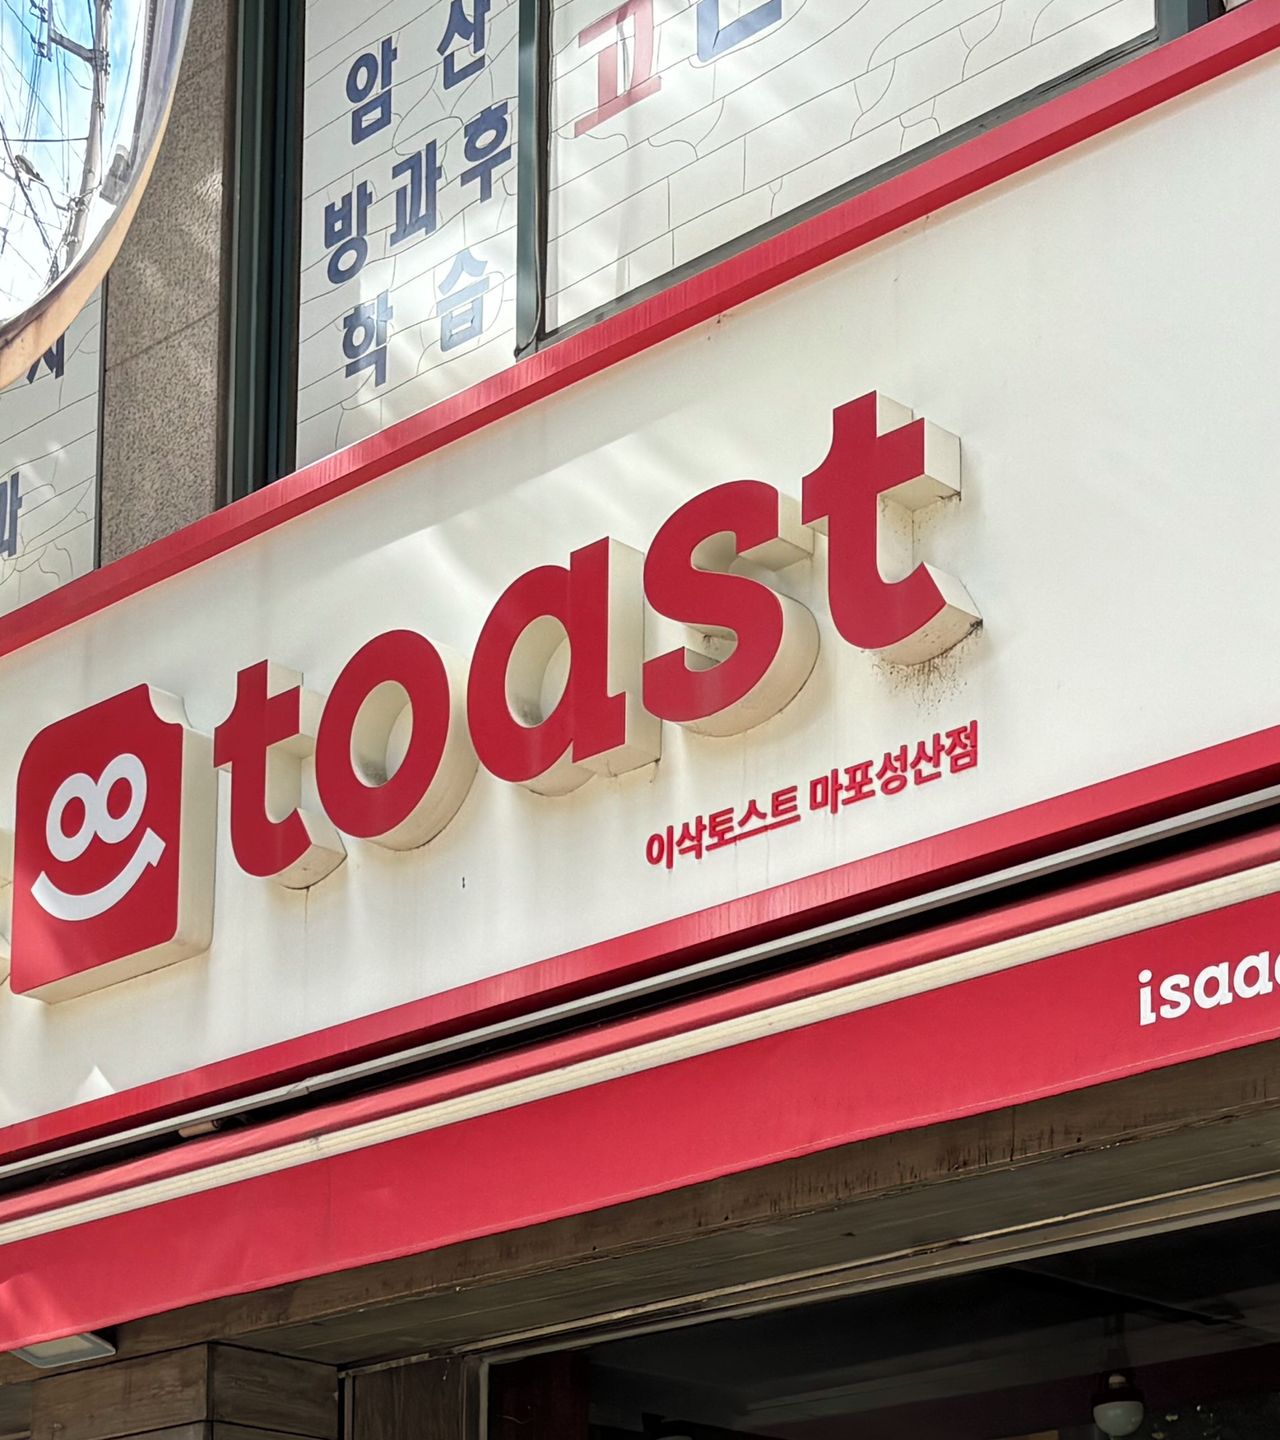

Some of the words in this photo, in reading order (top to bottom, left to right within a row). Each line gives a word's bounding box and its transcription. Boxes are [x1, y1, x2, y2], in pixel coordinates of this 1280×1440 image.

[324, 100, 512, 285] 방과후
[342, 251, 489, 388] 학습
[212, 389, 952, 882] toast
[645, 785, 801, 870] 이삭토스트
[809, 719, 978, 814] 마포성산점
